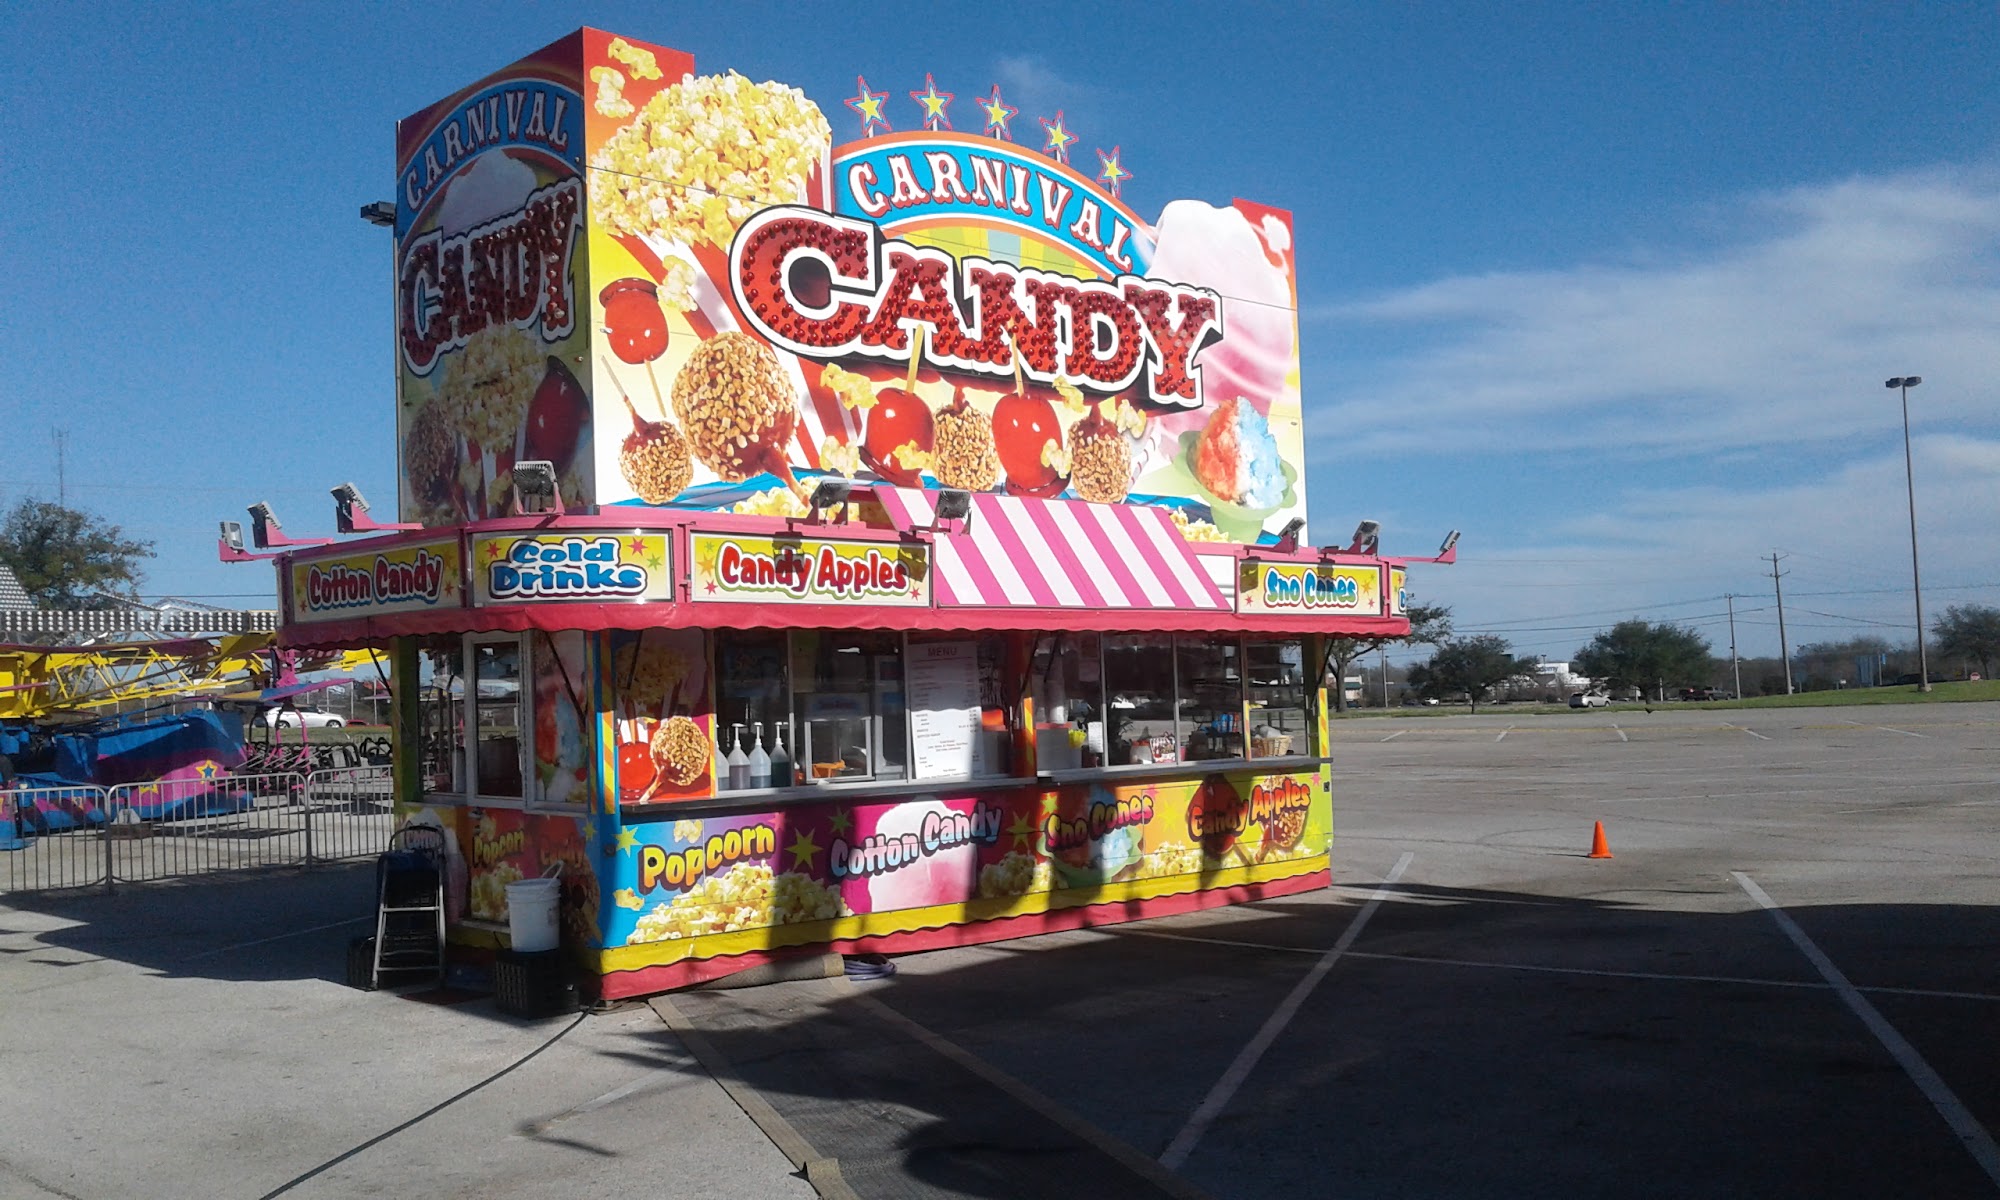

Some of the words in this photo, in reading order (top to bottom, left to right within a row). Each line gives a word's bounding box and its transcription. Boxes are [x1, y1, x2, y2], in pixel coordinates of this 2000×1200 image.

[406, 90, 568, 211] CARNIVAL
[848, 150, 1132, 272] CARNIVAL
[400, 180, 582, 372] CANDY
[733, 210, 1219, 404] CANDY
[309, 566, 372, 606] Cotton
[374, 550, 443, 601] Candy
[490, 562, 644, 592] Drinks
[511, 540, 617, 565] Cold
[720, 544, 812, 592] Candy
[816, 548, 907, 594] Apples
[1266, 568, 1301, 604] Sno
[1303, 570, 1357, 605] Cones
[928, 648, 957, 656] MENU
[1046, 815, 1089, 848] Sno
[1090, 795, 1153, 838] Cones
[1190, 797, 1249, 840] Candy
[1250, 777, 1311, 821] Apples
[473, 830, 525, 865] Popcorn
[641, 825, 776, 890] Popcorn
[830, 834, 920, 877] Cotton
[922, 802, 1002, 850] Candy
